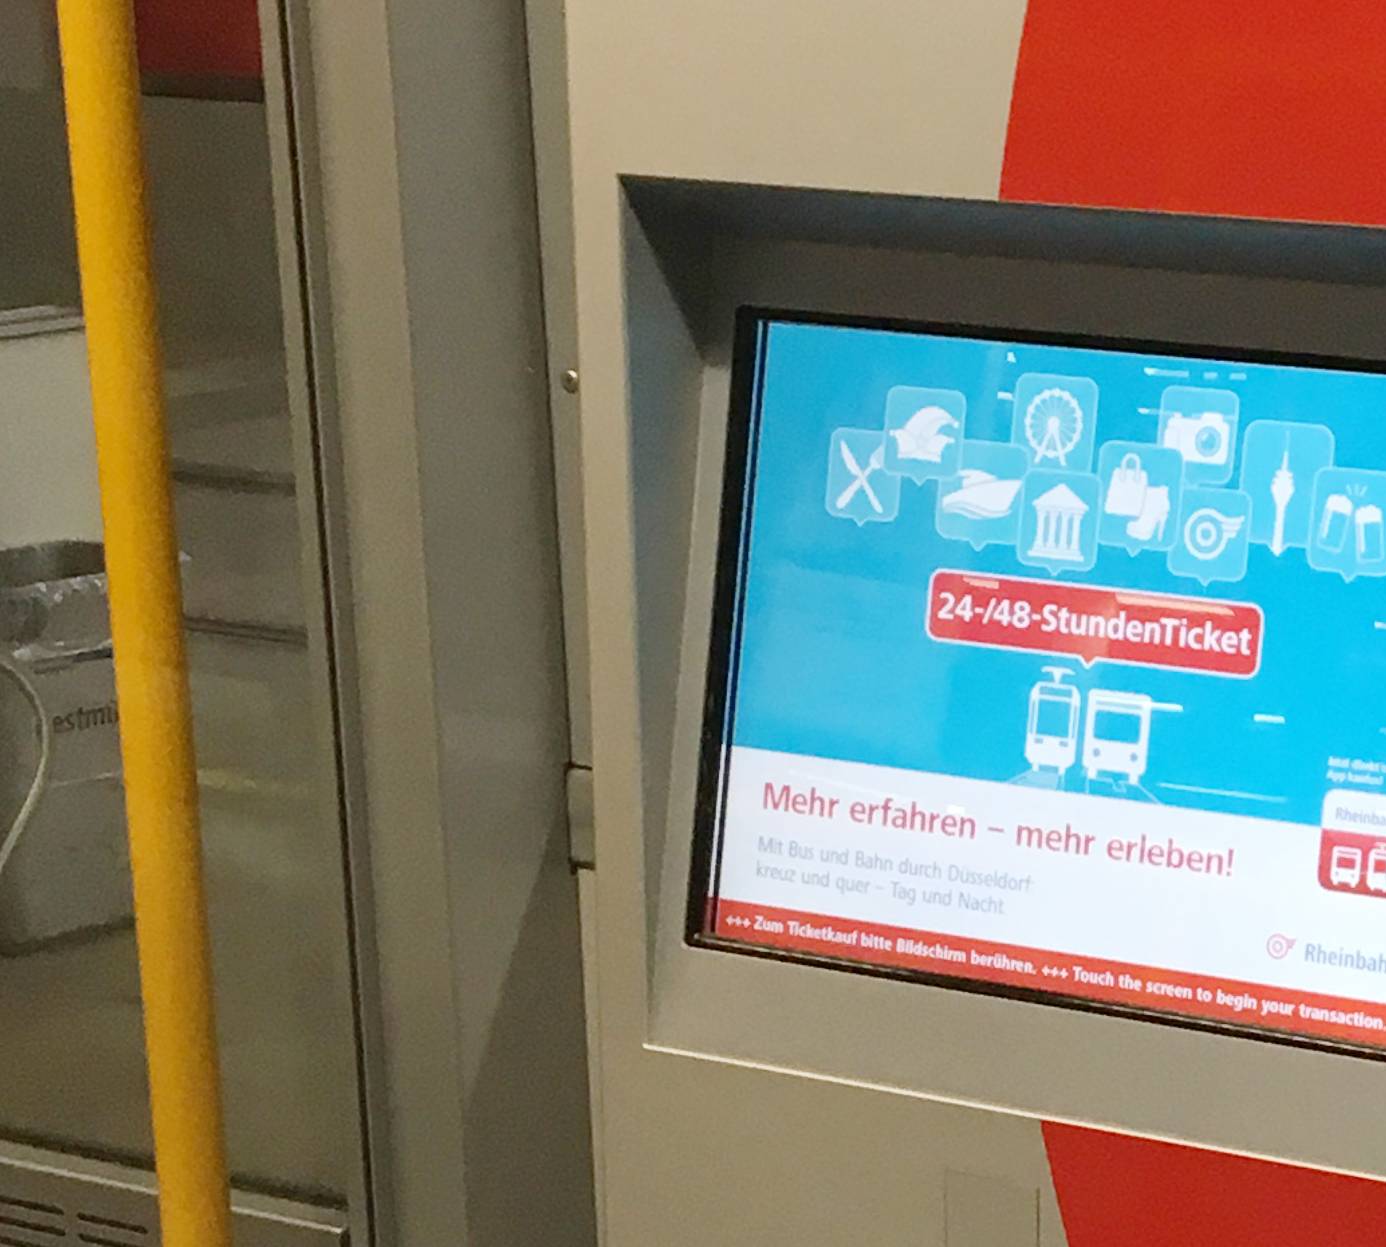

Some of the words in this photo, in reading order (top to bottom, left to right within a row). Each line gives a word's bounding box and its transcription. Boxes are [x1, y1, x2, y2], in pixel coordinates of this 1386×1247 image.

[937, 592, 1252, 656] 24-/48-StundenTicket
[758, 836, 783, 854] Mit
[788, 841, 815, 859] Bus
[820, 845, 849, 866] und
[855, 849, 893, 872] Bahn
[899, 856, 942, 880] durch
[763, 782, 839, 818] Mehr
[850, 797, 976, 839] erfahren
[1016, 824, 1096, 856] mehr
[1107, 834, 1235, 876] erleben!
[756, 861, 796, 883] kreuz
[801, 868, 830, 889] und
[836, 876, 870, 896] quer
[890, 881, 916, 906] Tag
[922, 887, 952, 907] und
[958, 892, 1005, 915] Nacht
[753, 914, 784, 935] Zum
[787, 919, 858, 946] Ticketkauf
[860, 933, 892, 952] bitte
[896, 938, 966, 964] Bildschirm
[970, 949, 1037, 976] berühren.
[1073, 965, 1114, 988] Touch
[1119, 974, 1142, 992] the
[1146, 980, 1192, 1001] screen
[1196, 986, 1213, 1003] to
[1216, 988, 1257, 1012] begin
[1261, 996, 1295, 1017] your
